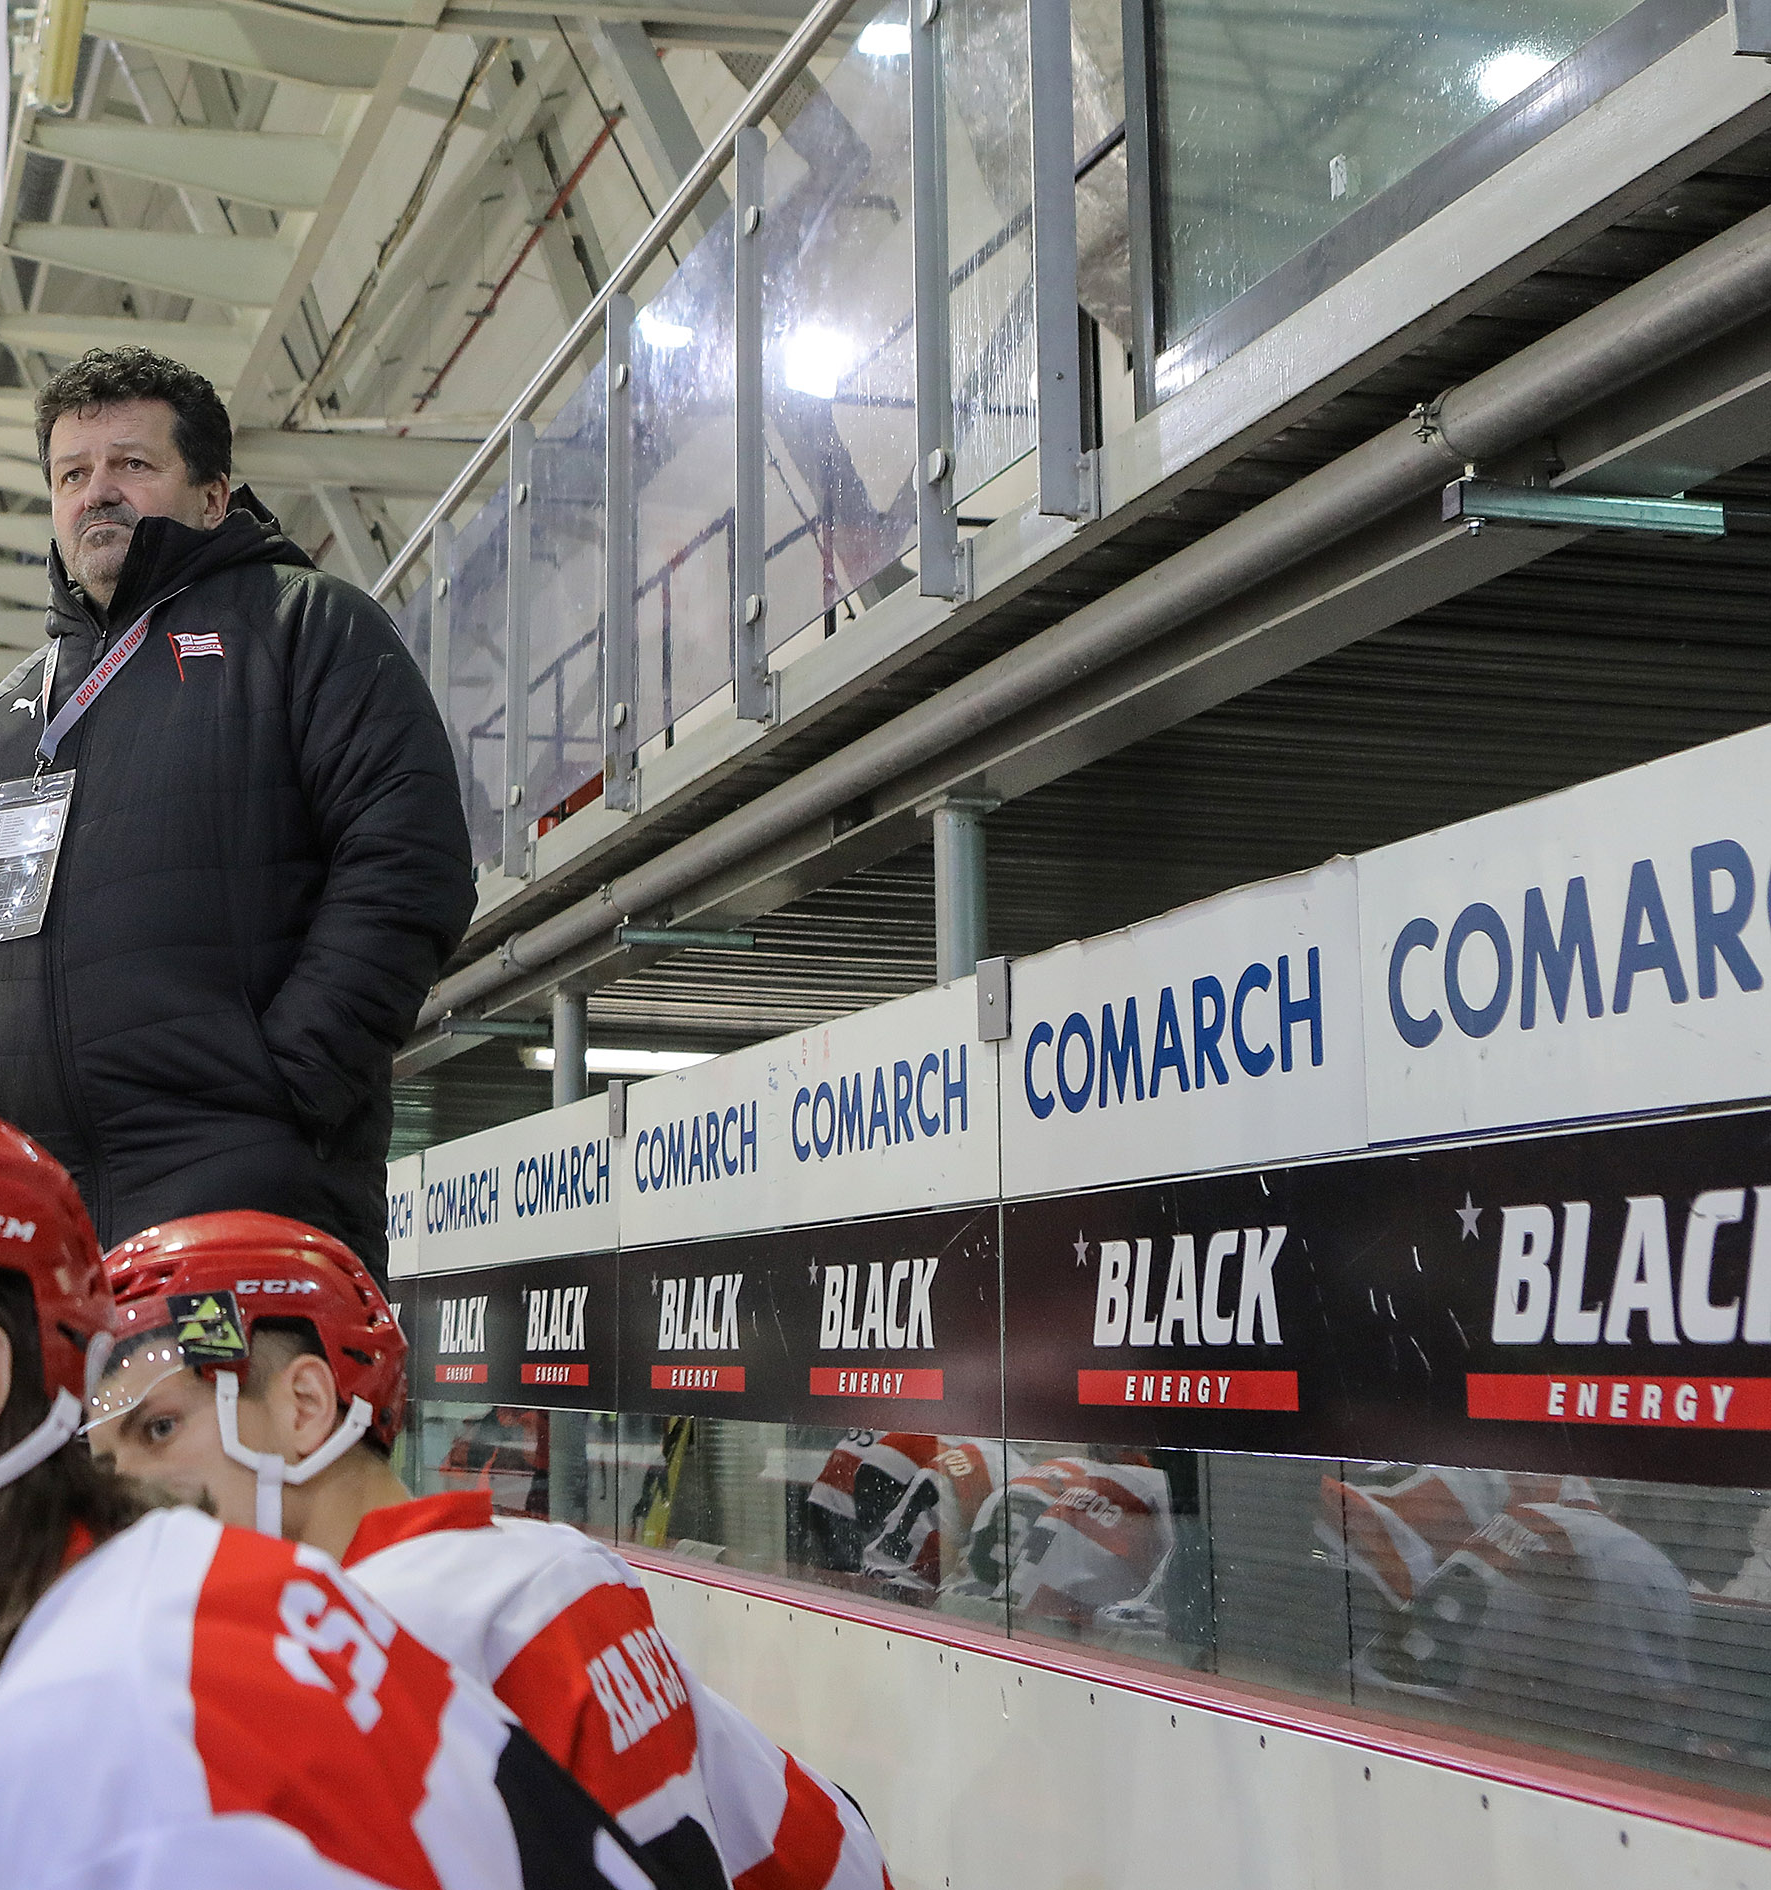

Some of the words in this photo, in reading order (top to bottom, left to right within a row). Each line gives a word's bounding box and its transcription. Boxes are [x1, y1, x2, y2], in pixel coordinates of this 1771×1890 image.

[76, 679, 99, 706] 2020
[96, 647, 126, 682] POLSKI
[1388, 838, 1771, 1048] COMAR
[1025, 946, 1324, 1119] COMARCH
[792, 1044, 968, 1162] COMARCH
[516, 1137, 610, 1217] COMARCH
[636, 1100, 757, 1193] COMARCH
[428, 1167, 499, 1234] COMARCH
[235, 1279, 320, 1294] CCM
[658, 1273, 744, 1351] BLACK
[819, 1257, 940, 1350] BLACK
[1094, 1225, 1287, 1347] BLACK
[439, 1295, 489, 1353] BLACK
[526, 1286, 589, 1351] BLACK
[445, 1366, 474, 1381] ENERGY
[535, 1366, 570, 1383] ENERGY
[671, 1368, 718, 1389] ENERGY
[838, 1371, 904, 1396] ENERGY
[1124, 1375, 1231, 1405] ENERGY
[1548, 1381, 1734, 1422] ENERGY
